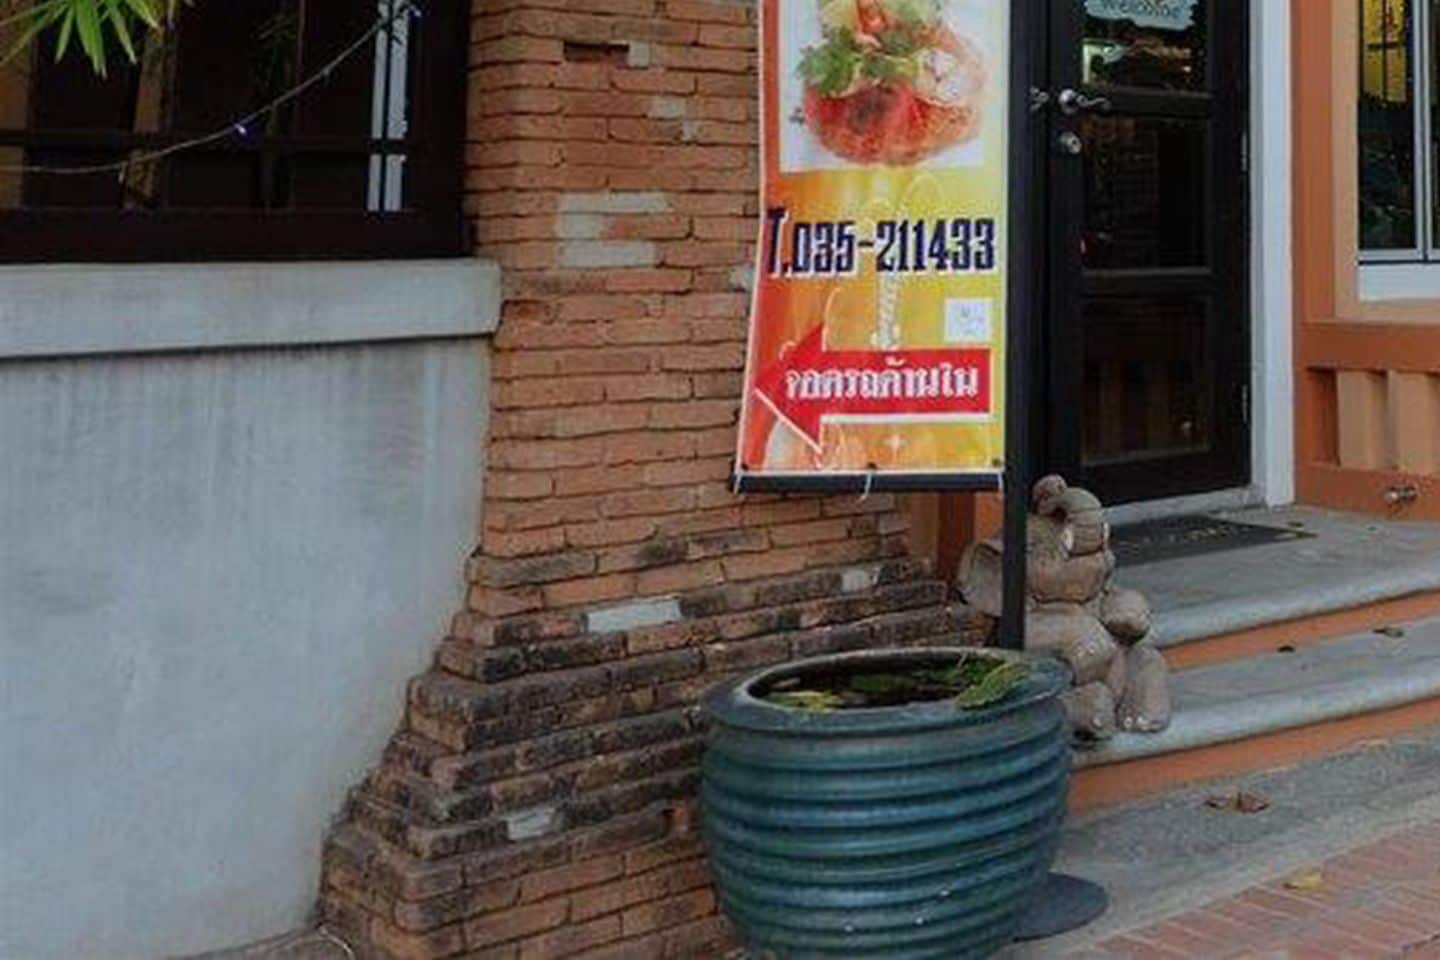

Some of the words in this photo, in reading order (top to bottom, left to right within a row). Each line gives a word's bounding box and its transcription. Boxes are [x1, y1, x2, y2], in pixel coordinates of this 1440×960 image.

[785, 356, 979, 399] จอดรถด้านใน
